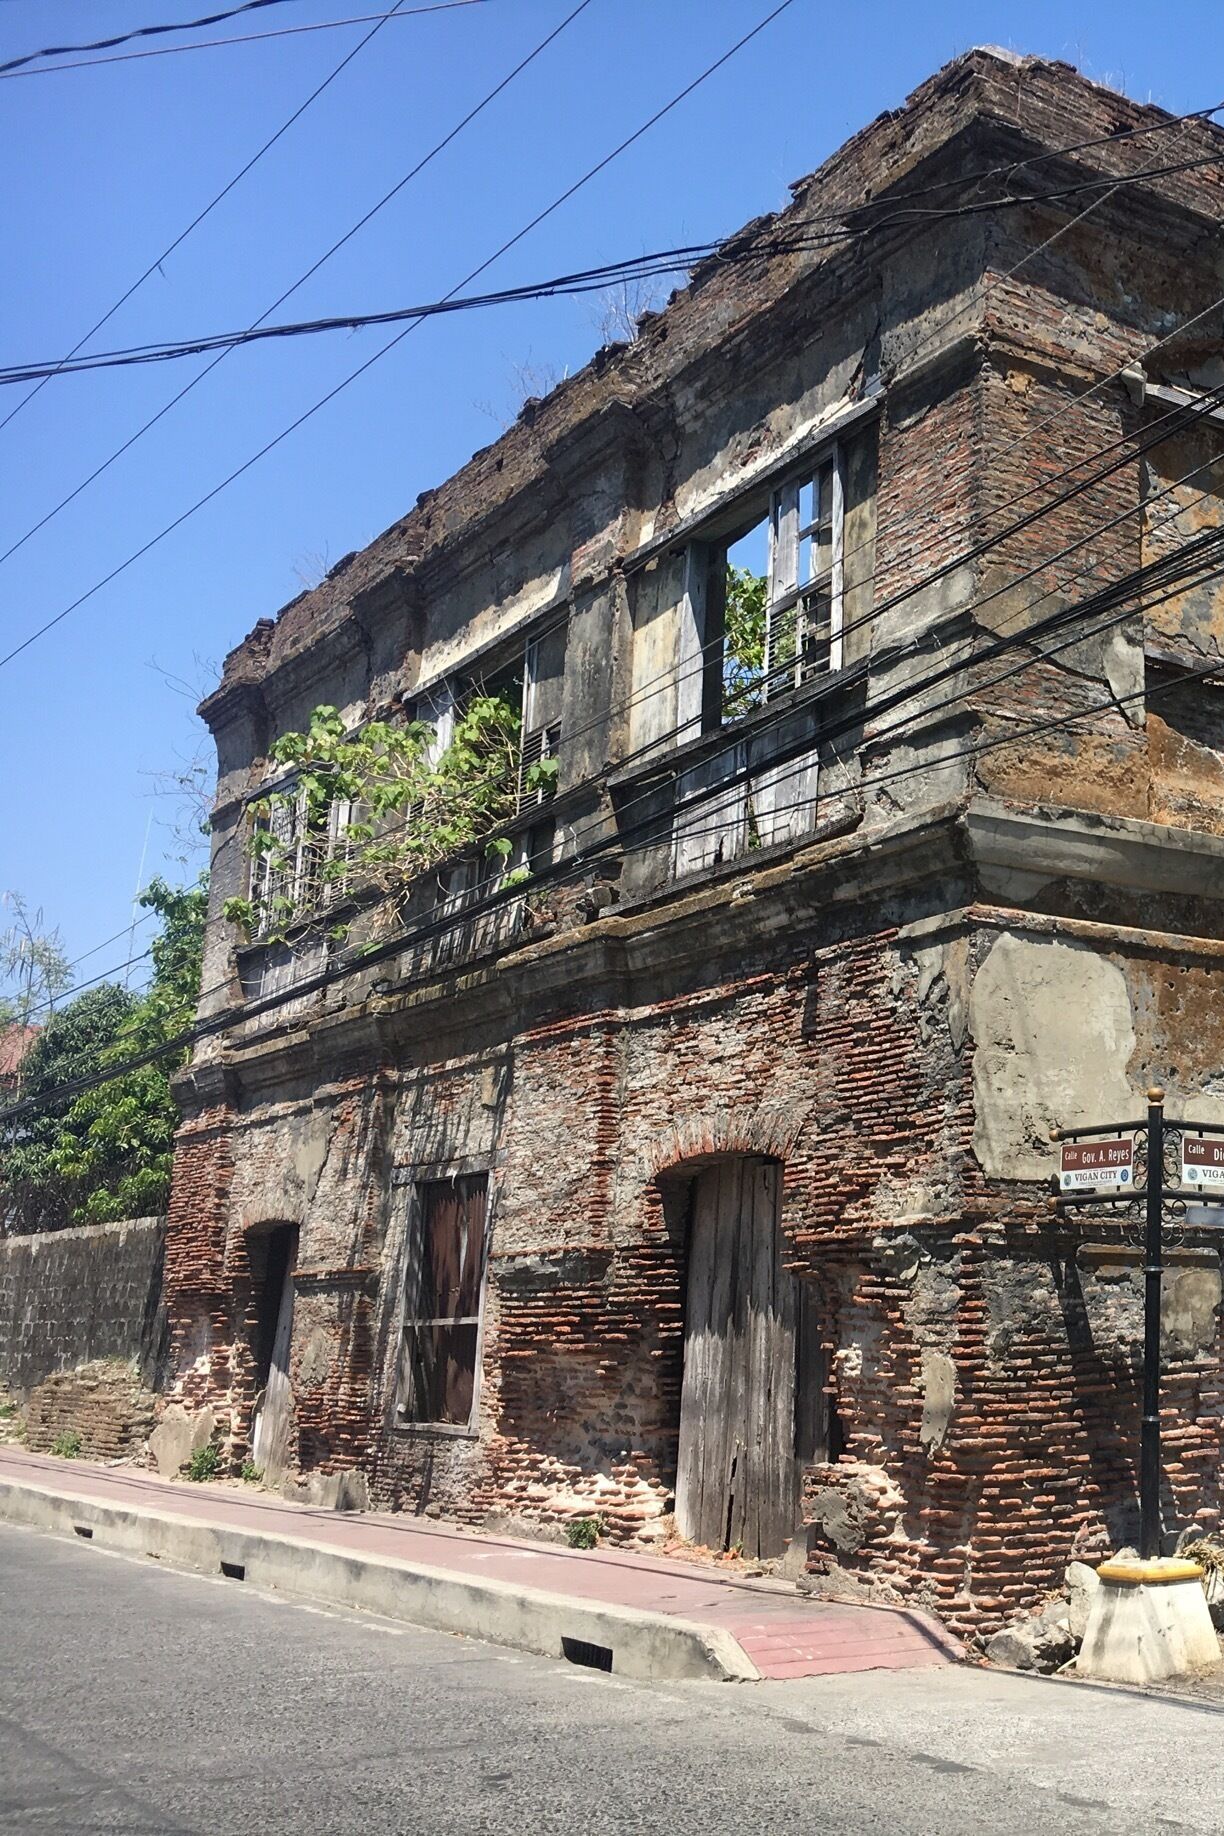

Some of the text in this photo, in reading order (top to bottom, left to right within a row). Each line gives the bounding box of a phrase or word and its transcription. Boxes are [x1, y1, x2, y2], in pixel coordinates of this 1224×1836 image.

[1188, 1144, 1205, 1154] Calle
[1064, 1149, 1130, 1164] Calle Gov. A. Reyes
[1074, 1170, 1118, 1182] VIGAN CITY
